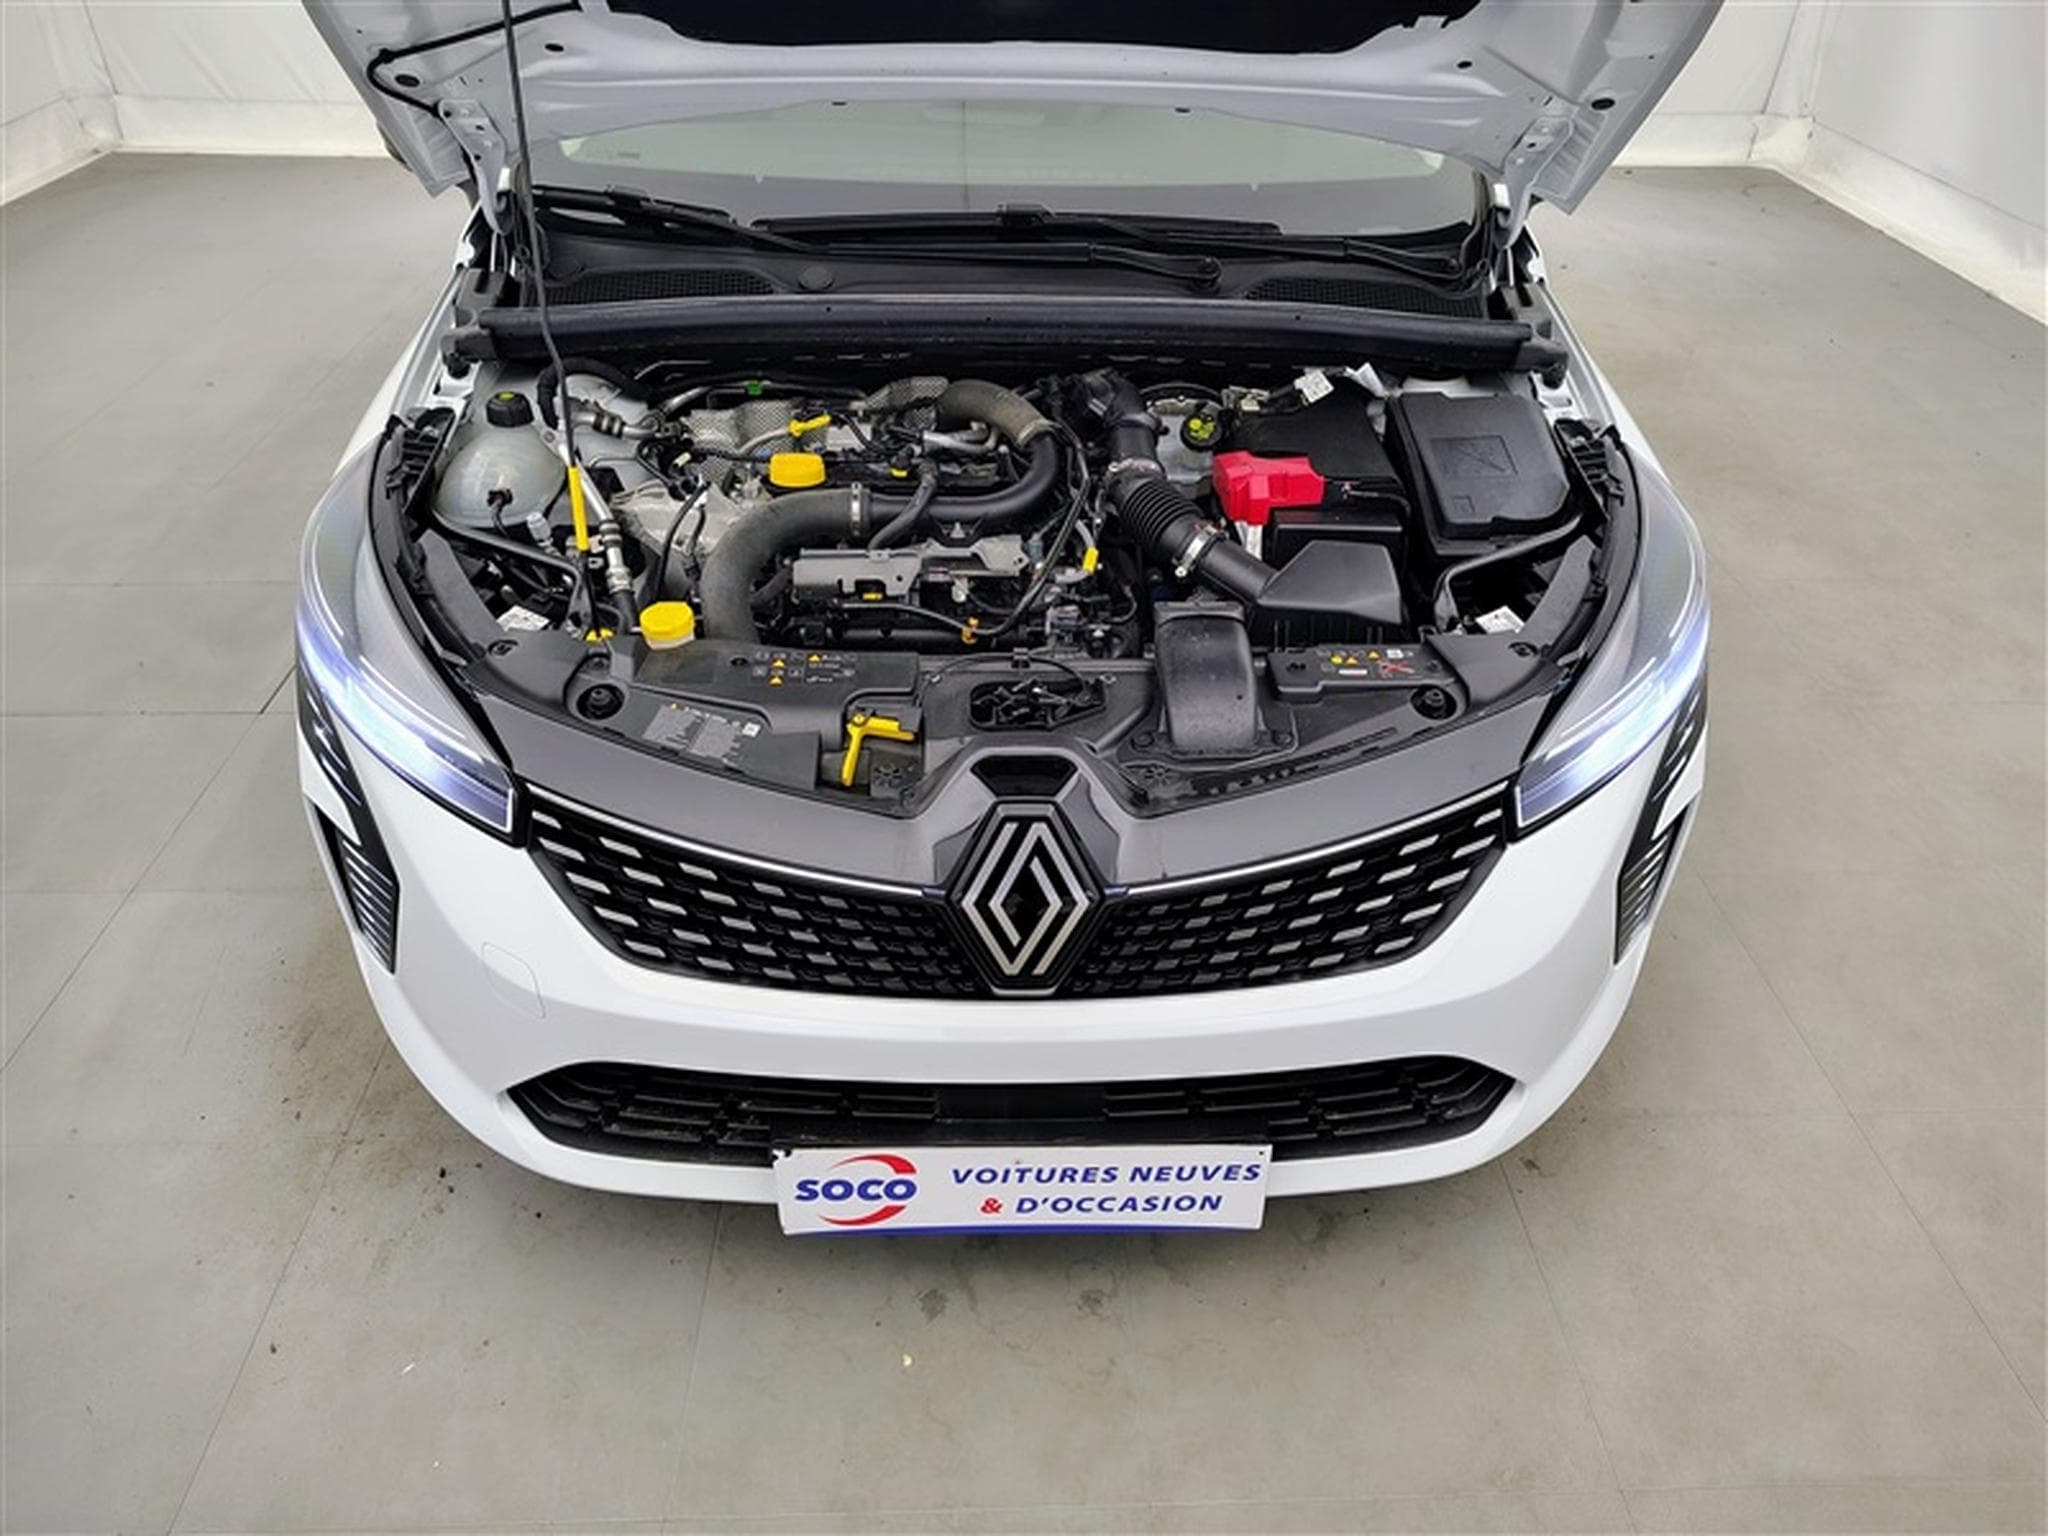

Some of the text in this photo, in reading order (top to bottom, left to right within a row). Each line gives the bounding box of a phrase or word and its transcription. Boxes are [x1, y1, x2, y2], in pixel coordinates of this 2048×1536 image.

[951, 1164, 1262, 1185] VOITURES NEUVES
[794, 1178, 918, 1202] SOCO
[980, 1195, 1222, 1214] & D'OCCASION
